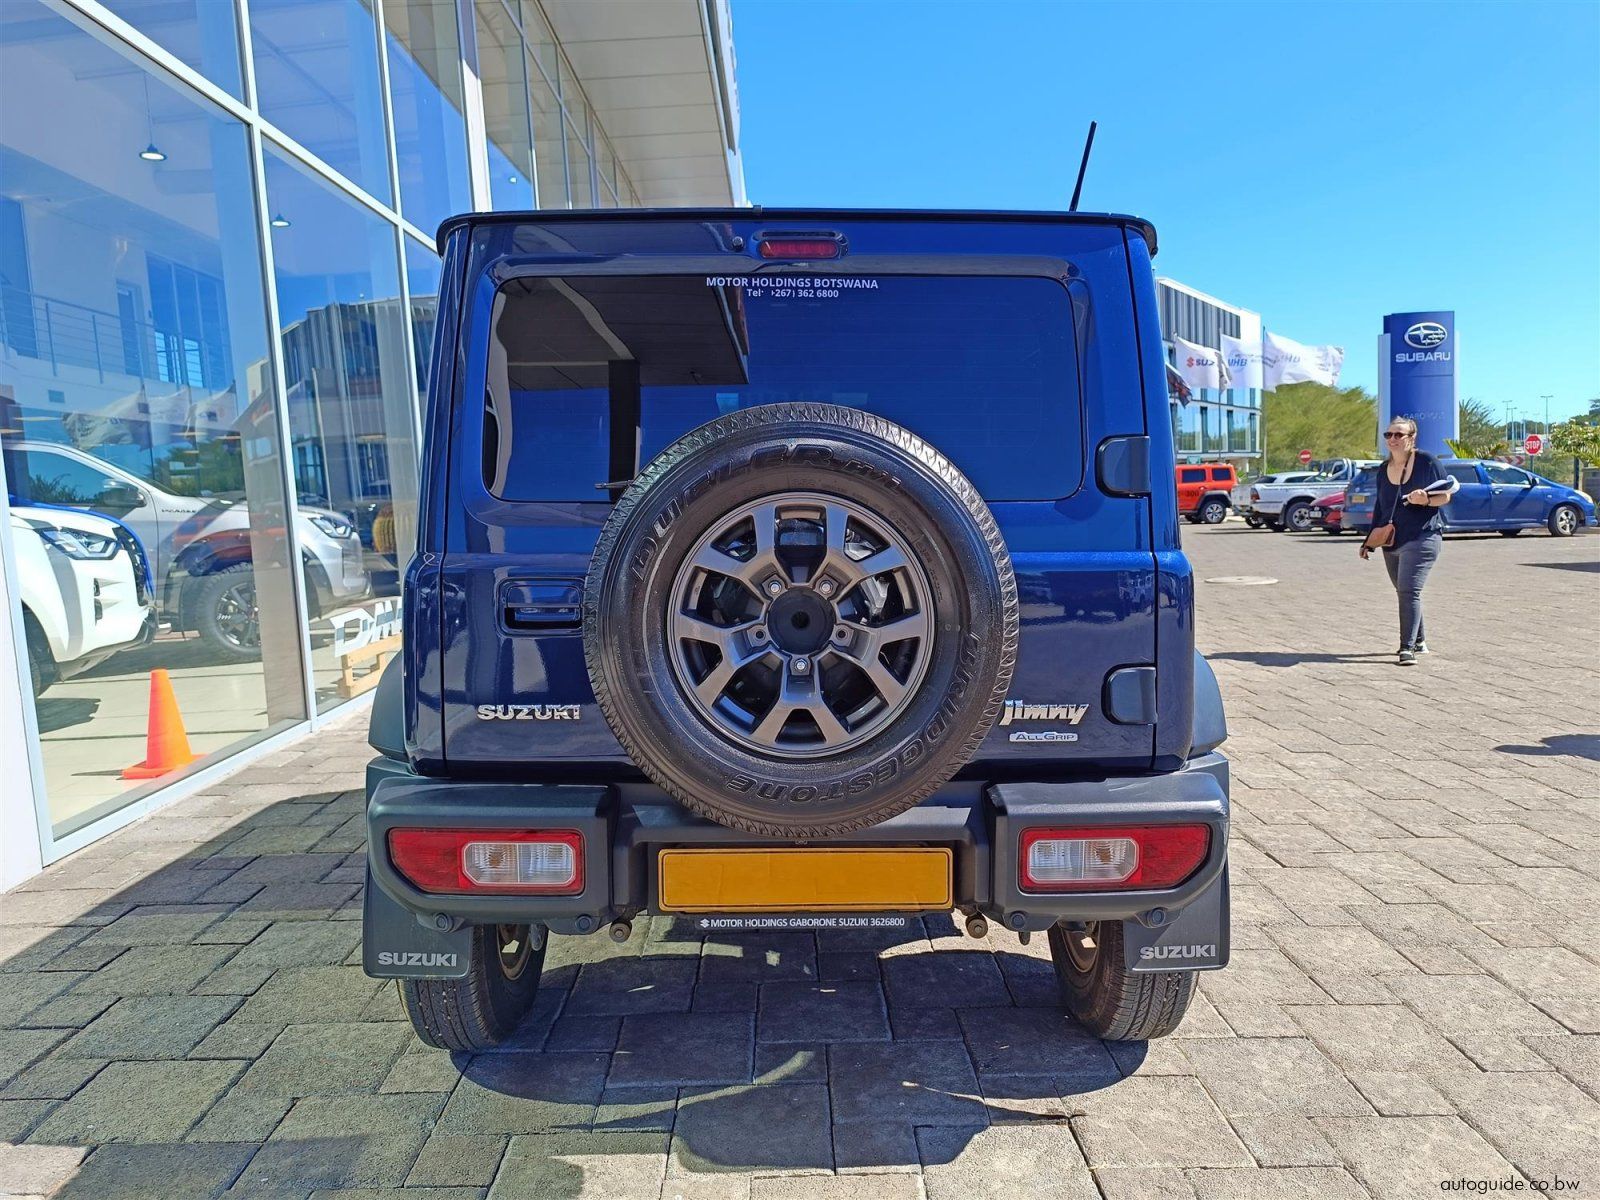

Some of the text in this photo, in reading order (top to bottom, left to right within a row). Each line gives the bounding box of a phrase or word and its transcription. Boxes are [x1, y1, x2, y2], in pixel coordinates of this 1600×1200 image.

[706, 277, 879, 289] MOTOR HOLDINGS BOTSWANA
[797, 289, 815, 298] 362
[816, 289, 839, 298] 6800
[1395, 351, 1451, 362] SUBARU
[1525, 440, 1540, 450] STOP
[477, 703, 580, 720] SUZUKI
[726, 631, 982, 804] BRIDGESTONE
[710, 917, 905, 928] MOTOR HOLDINGS GABORONE SUZUKI 3626800
[1140, 944, 1216, 960] SUZUKI
[378, 951, 457, 968] SUZUKI
